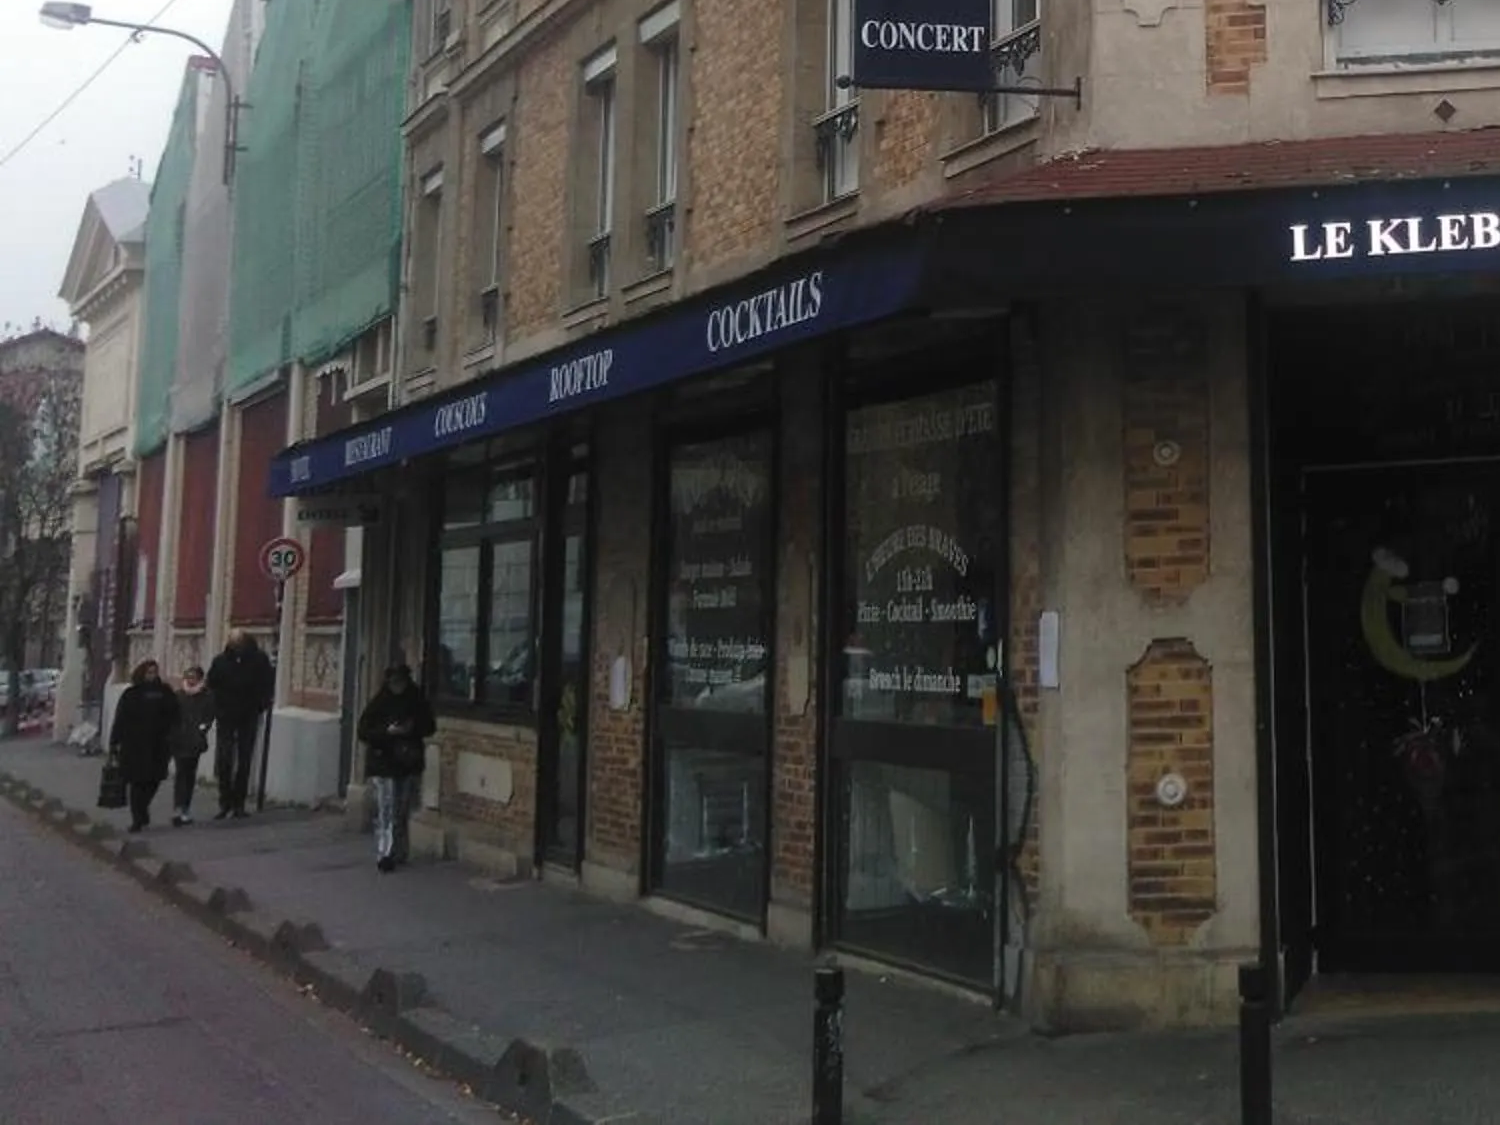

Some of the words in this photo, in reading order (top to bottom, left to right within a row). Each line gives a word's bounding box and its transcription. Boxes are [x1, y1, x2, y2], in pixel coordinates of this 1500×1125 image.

[861, 20, 985, 52] CONCERT
[1289, 221, 1354, 262] LE
[707, 271, 824, 352] COCKTAILS
[549, 349, 613, 403] ROOFTOP
[435, 391, 488, 438] COUSCOUS
[271, 551, 297, 567] 30
